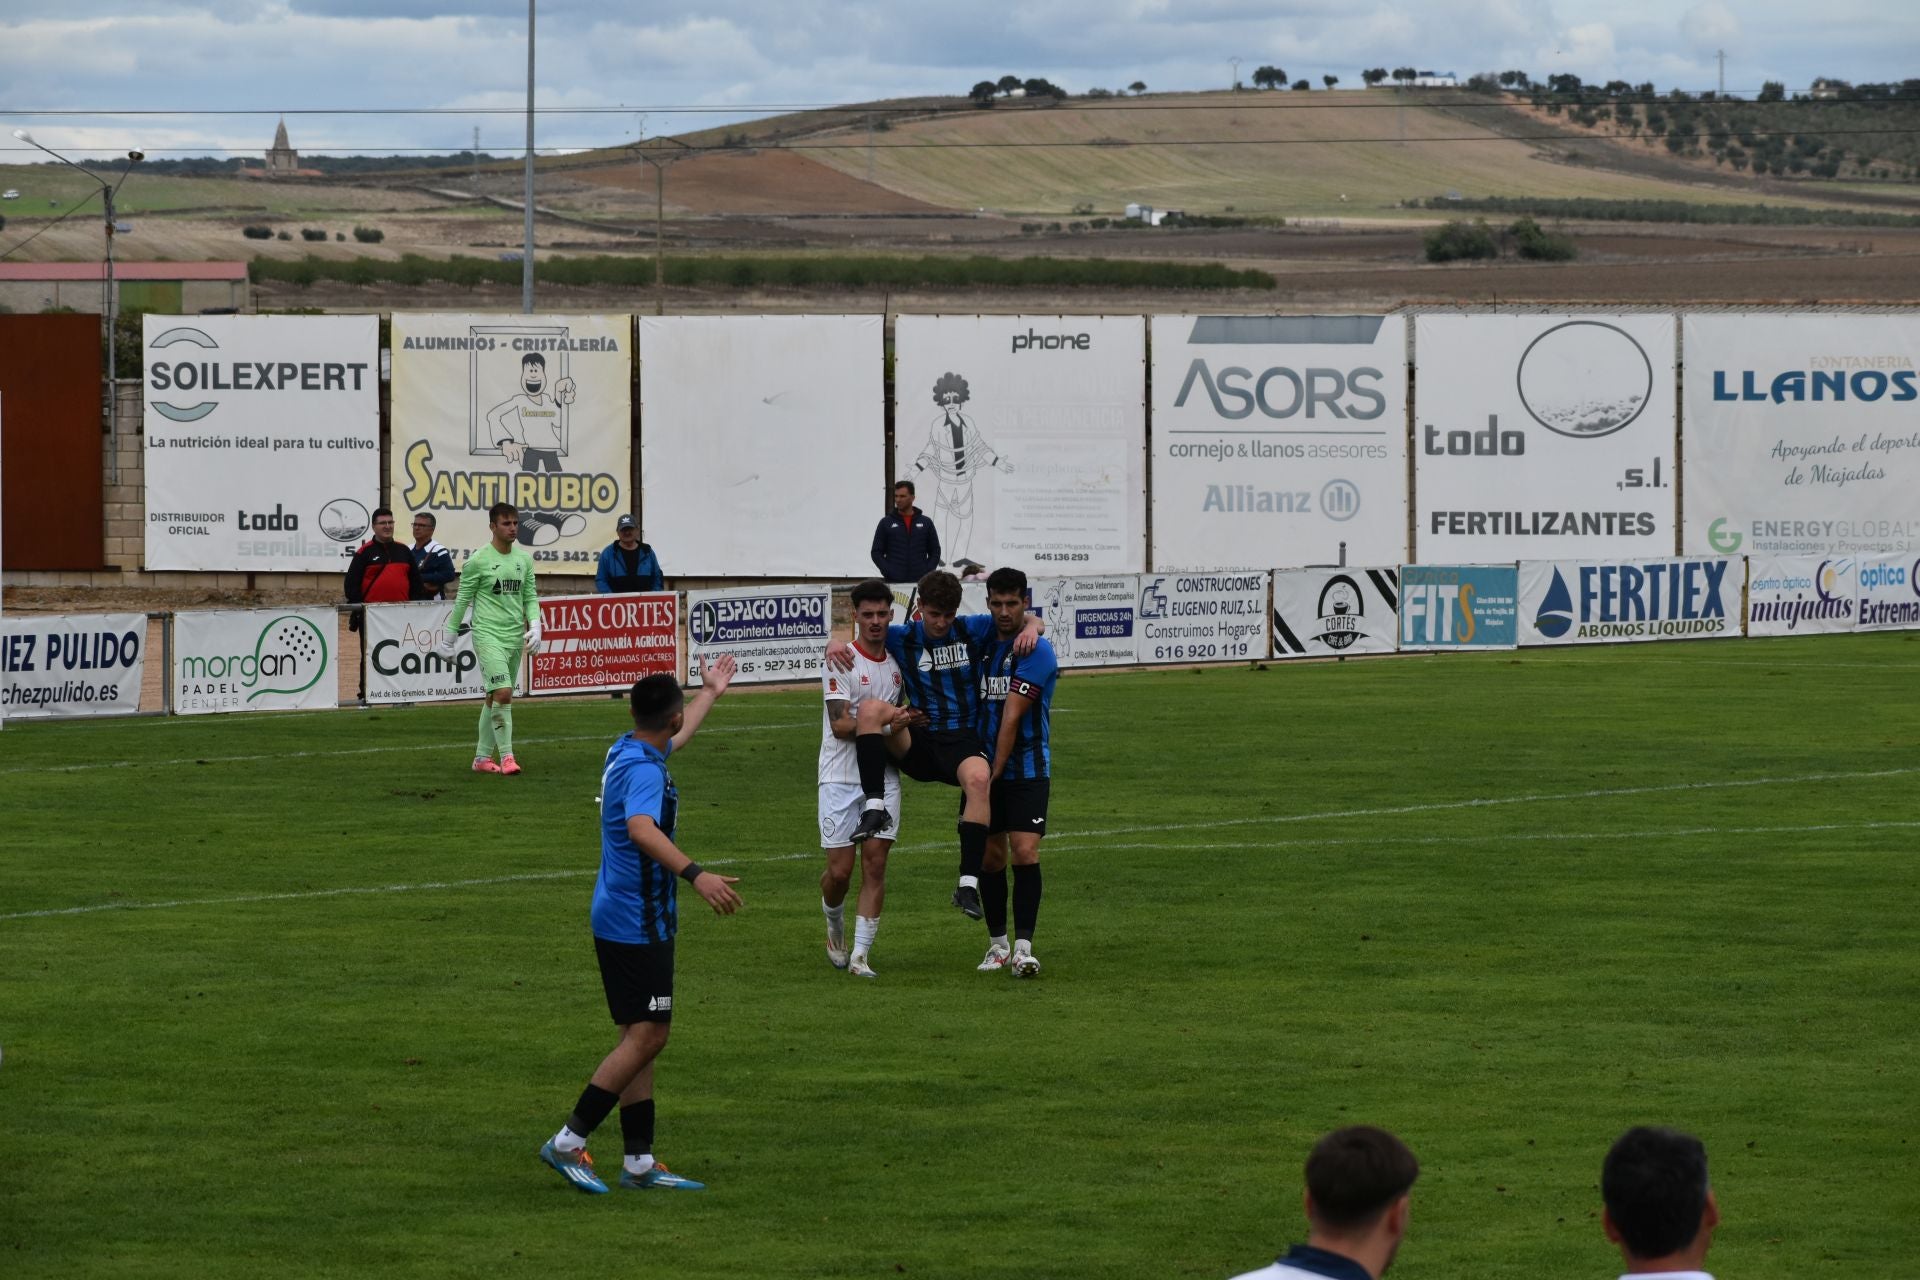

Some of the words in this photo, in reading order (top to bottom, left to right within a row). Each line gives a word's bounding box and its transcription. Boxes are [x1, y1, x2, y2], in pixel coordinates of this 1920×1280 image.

[403, 336, 496, 351] ALUMINIOS
[512, 337, 618, 352] CRISTALERÍA
[1012, 328, 1090, 353] phone
[150, 361, 368, 391] SOILEXPERT
[1173, 358, 1386, 421] ASORS
[1713, 370, 1918, 405] LLANOS
[150, 437, 165, 449] La
[170, 436, 231, 449] nutrición
[236, 437, 268, 449] ideal
[274, 439, 304, 451] para
[309, 438, 322, 449] tu
[327, 437, 374, 449] cultivo
[1425, 414, 1525, 456] todo
[1169, 440, 1234, 462] cornejo
[1238, 443, 1249, 457] &
[1252, 440, 1304, 458] llanos
[1308, 443, 1387, 458] asesores
[1771, 437, 1845, 462] Apoyando
[1852, 434, 1867, 452] el
[404, 439, 510, 511] SANTI
[515, 472, 619, 513] RUBIO
[1785, 466, 1803, 486] de
[1810, 462, 1886, 488] Miajadas
[1203, 485, 1311, 513] Allianz
[151, 513, 225, 523] DISTRIBUIDOR
[238, 504, 298, 531] todo
[1431, 511, 1656, 536] FERTILIZANTES
[169, 526, 210, 535] OFICIAL
[1752, 540, 1825, 551] Instalaciones
[533, 551, 559, 561] 625
[563, 551, 589, 562] 342
[1035, 553, 1052, 561] 645
[1054, 553, 1070, 561] 136
[1071, 553, 1089, 561] 293
[1176, 576, 1261, 592] CONSTRUCIONES
[1752, 575, 1780, 591] centro
[1782, 573, 1811, 593] óptico
[1860, 562, 1905, 591] óptica
[1579, 560, 1728, 623] FERTIEX
[598, 601, 674, 630] CORTES
[782, 597, 821, 619] LORO
[1077, 612, 1118, 623] URGENCIAS
[1119, 611, 1132, 621] 24h
[1172, 601, 1217, 616] EUGENIO
[1220, 600, 1245, 616] RUIZ,
[1247, 599, 1262, 615] S.L.
[1404, 584, 1475, 643] FITS
[1751, 591, 1852, 630] miajadas
[1099, 625, 1110, 635] 708
[1112, 625, 1124, 634] 625
[1145, 623, 1214, 639] Construimos
[1218, 621, 1261, 640] Hogares
[1578, 622, 1644, 638] ABONOS
[1648, 618, 1725, 637] LÍQUIDOS
[635, 632, 675, 649] AGRÍCOLA
[1155, 645, 1183, 658] 616
[1188, 644, 1216, 657] 920
[1221, 643, 1248, 656] 119
[46, 631, 139, 671] PULIDO
[605, 654, 640, 664] MIAJADAS
[932, 643, 970, 665] FERTIEX
[182, 654, 296, 688] morgan
[536, 657, 556, 671] 927
[559, 656, 572, 669] 34
[575, 655, 587, 668] 83
[590, 654, 604, 667] 06
[742, 662, 754, 673] 65
[765, 661, 784, 671] 927
[788, 659, 801, 670] 34
[804, 659, 816, 669] 86
[182, 683, 239, 695] PADEL
[436, 688, 467, 696] MIAJADAS
[1019, 682, 1029, 694] C
[182, 699, 239, 709] CENTER
